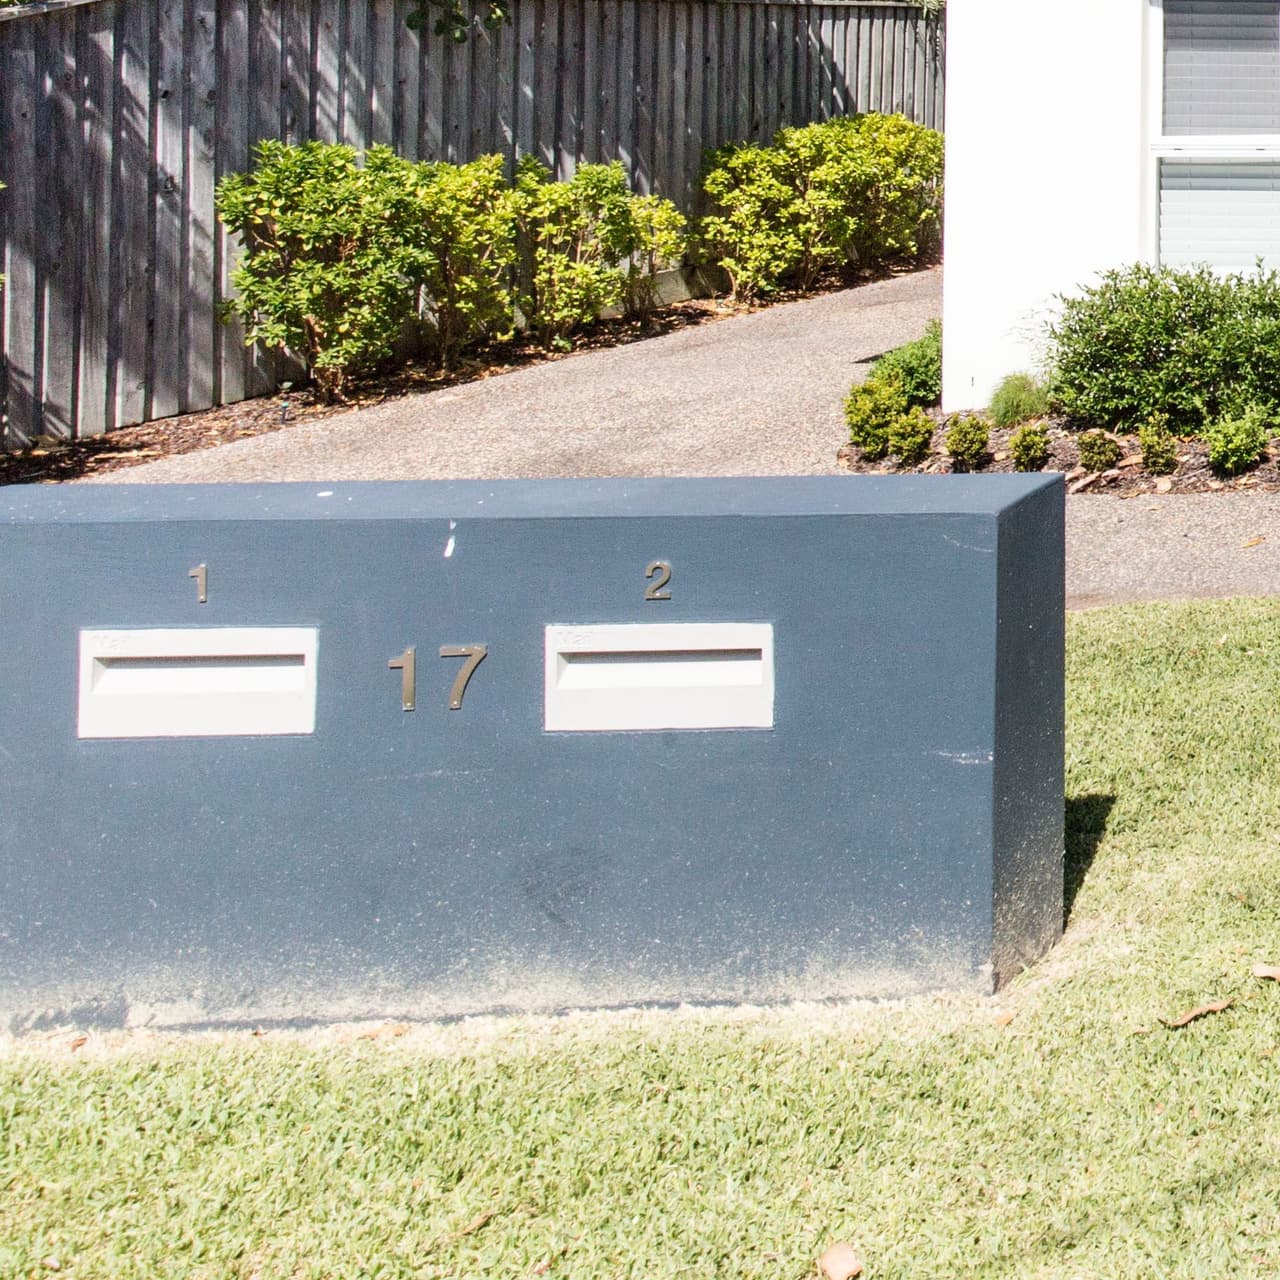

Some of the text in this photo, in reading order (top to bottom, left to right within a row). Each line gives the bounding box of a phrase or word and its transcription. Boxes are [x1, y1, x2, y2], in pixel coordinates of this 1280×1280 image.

[188, 563, 208, 604] 1
[644, 560, 672, 601] 2
[387, 643, 489, 713] 17
